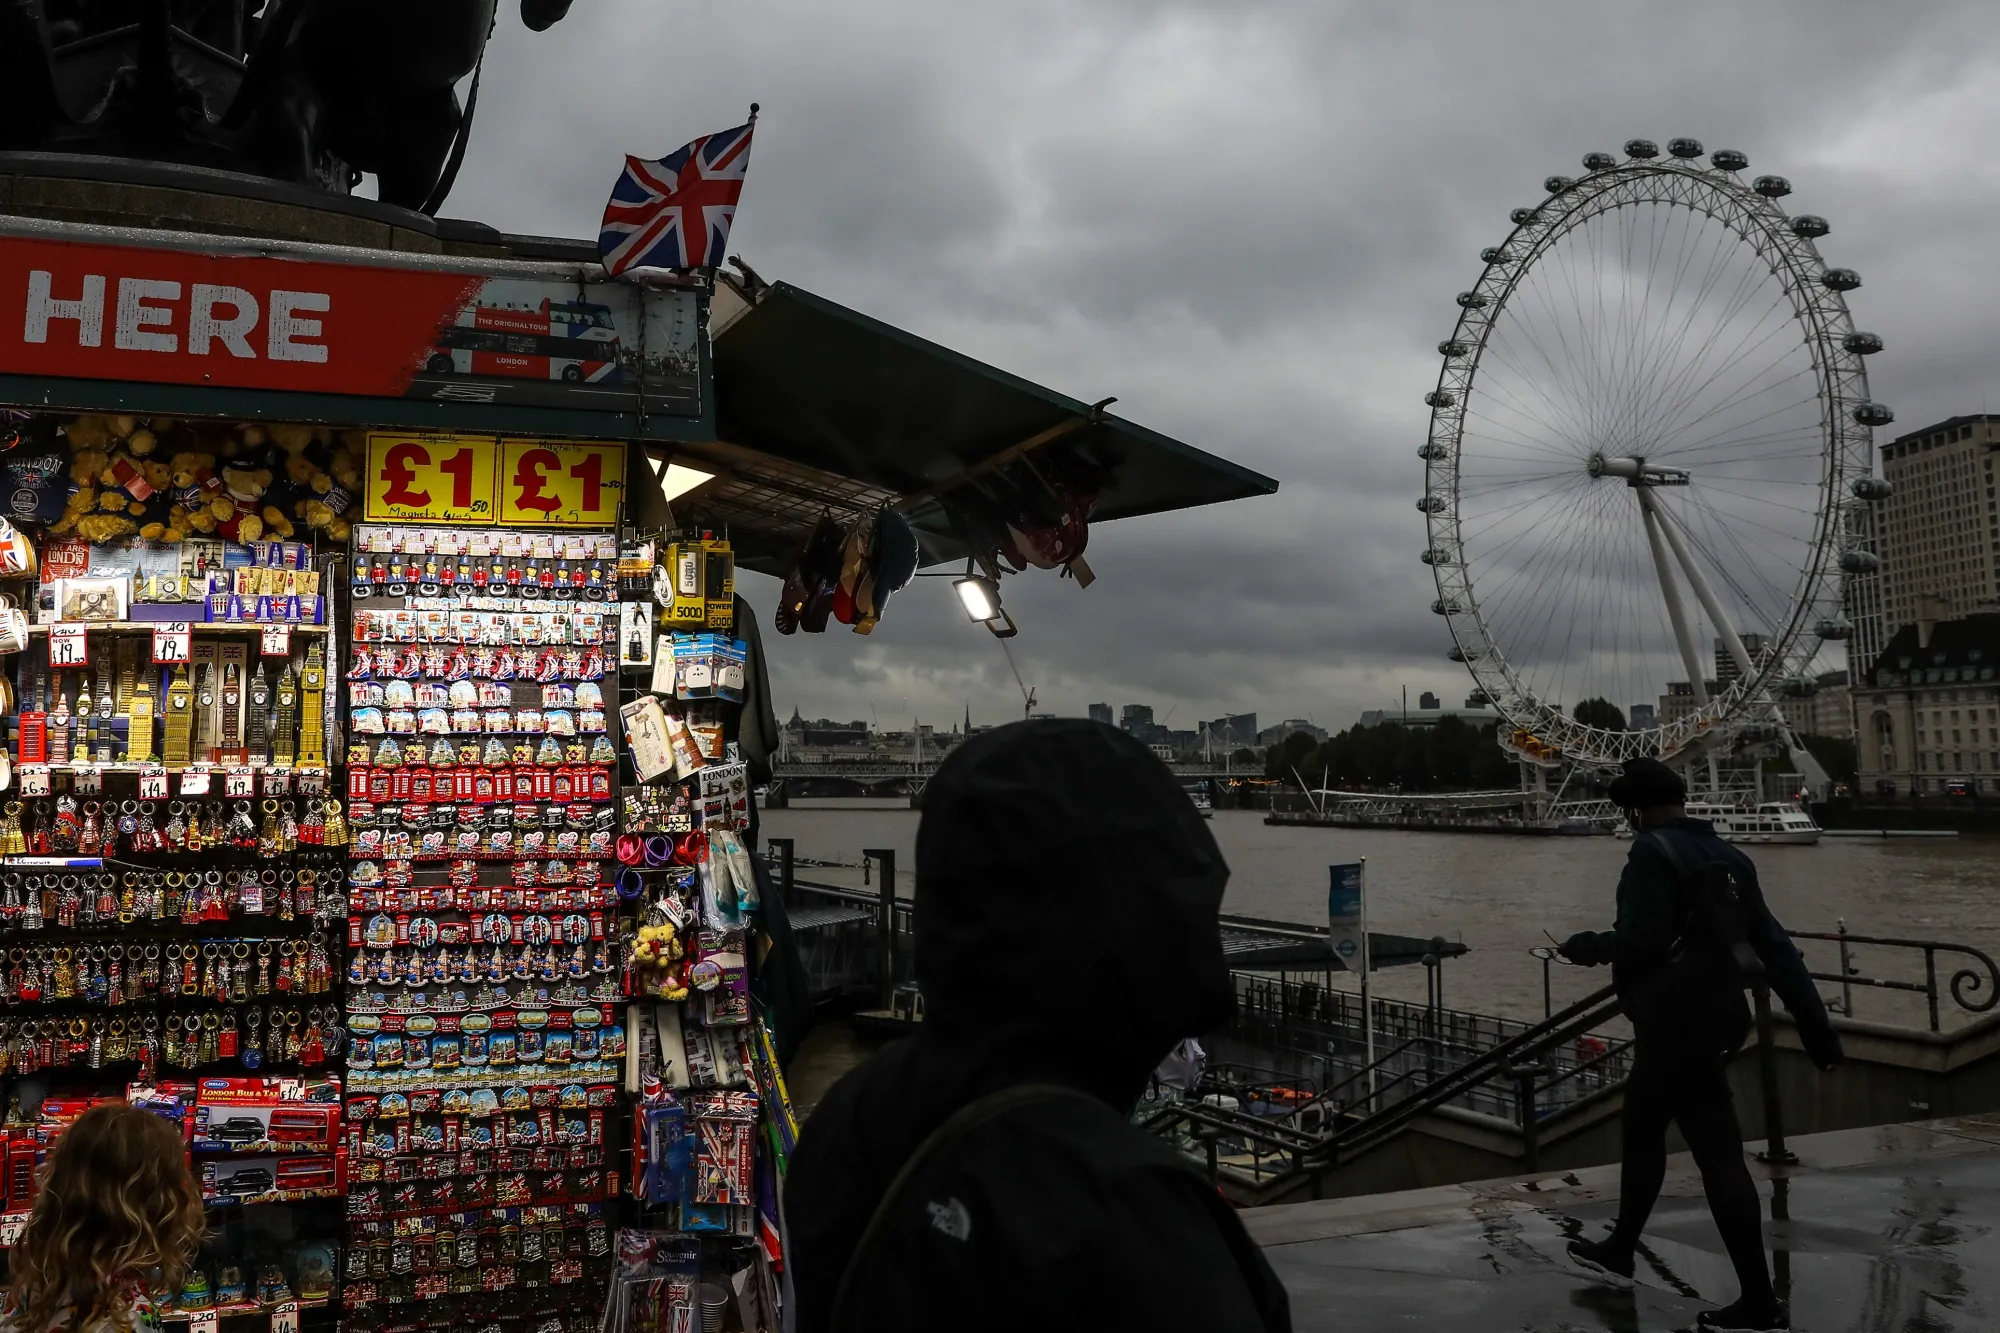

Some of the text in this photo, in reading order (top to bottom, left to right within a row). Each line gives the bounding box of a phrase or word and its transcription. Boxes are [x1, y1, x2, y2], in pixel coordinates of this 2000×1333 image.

[24, 270, 330, 363] HERE
[477, 317, 549, 332] THE ORIGINAL TOUR
[496, 356, 528, 366] LONDON
[7, 457, 63, 474] LONDON
[380, 443, 474, 508] £1
[513, 448, 603, 512] £1
[388, 507, 437, 521] Magnets
[50, 543, 63, 551] WE
[676, 606, 703, 618] 5000
[702, 766, 744, 782] LONDON
[201, 1089, 235, 1097] LONDON
[236, 1089, 254, 1097] BUS
[229, 1142, 271, 1150] LONDON
[272, 1142, 293, 1150] BUS
[305, 1142, 329, 1150] TAXI
[239, 1193, 280, 1203] LONDON
[283, 1191, 303, 1199] BUS
[315, 1188, 339, 1196] TAXI
[656, 1249, 697, 1263] Souvenir
